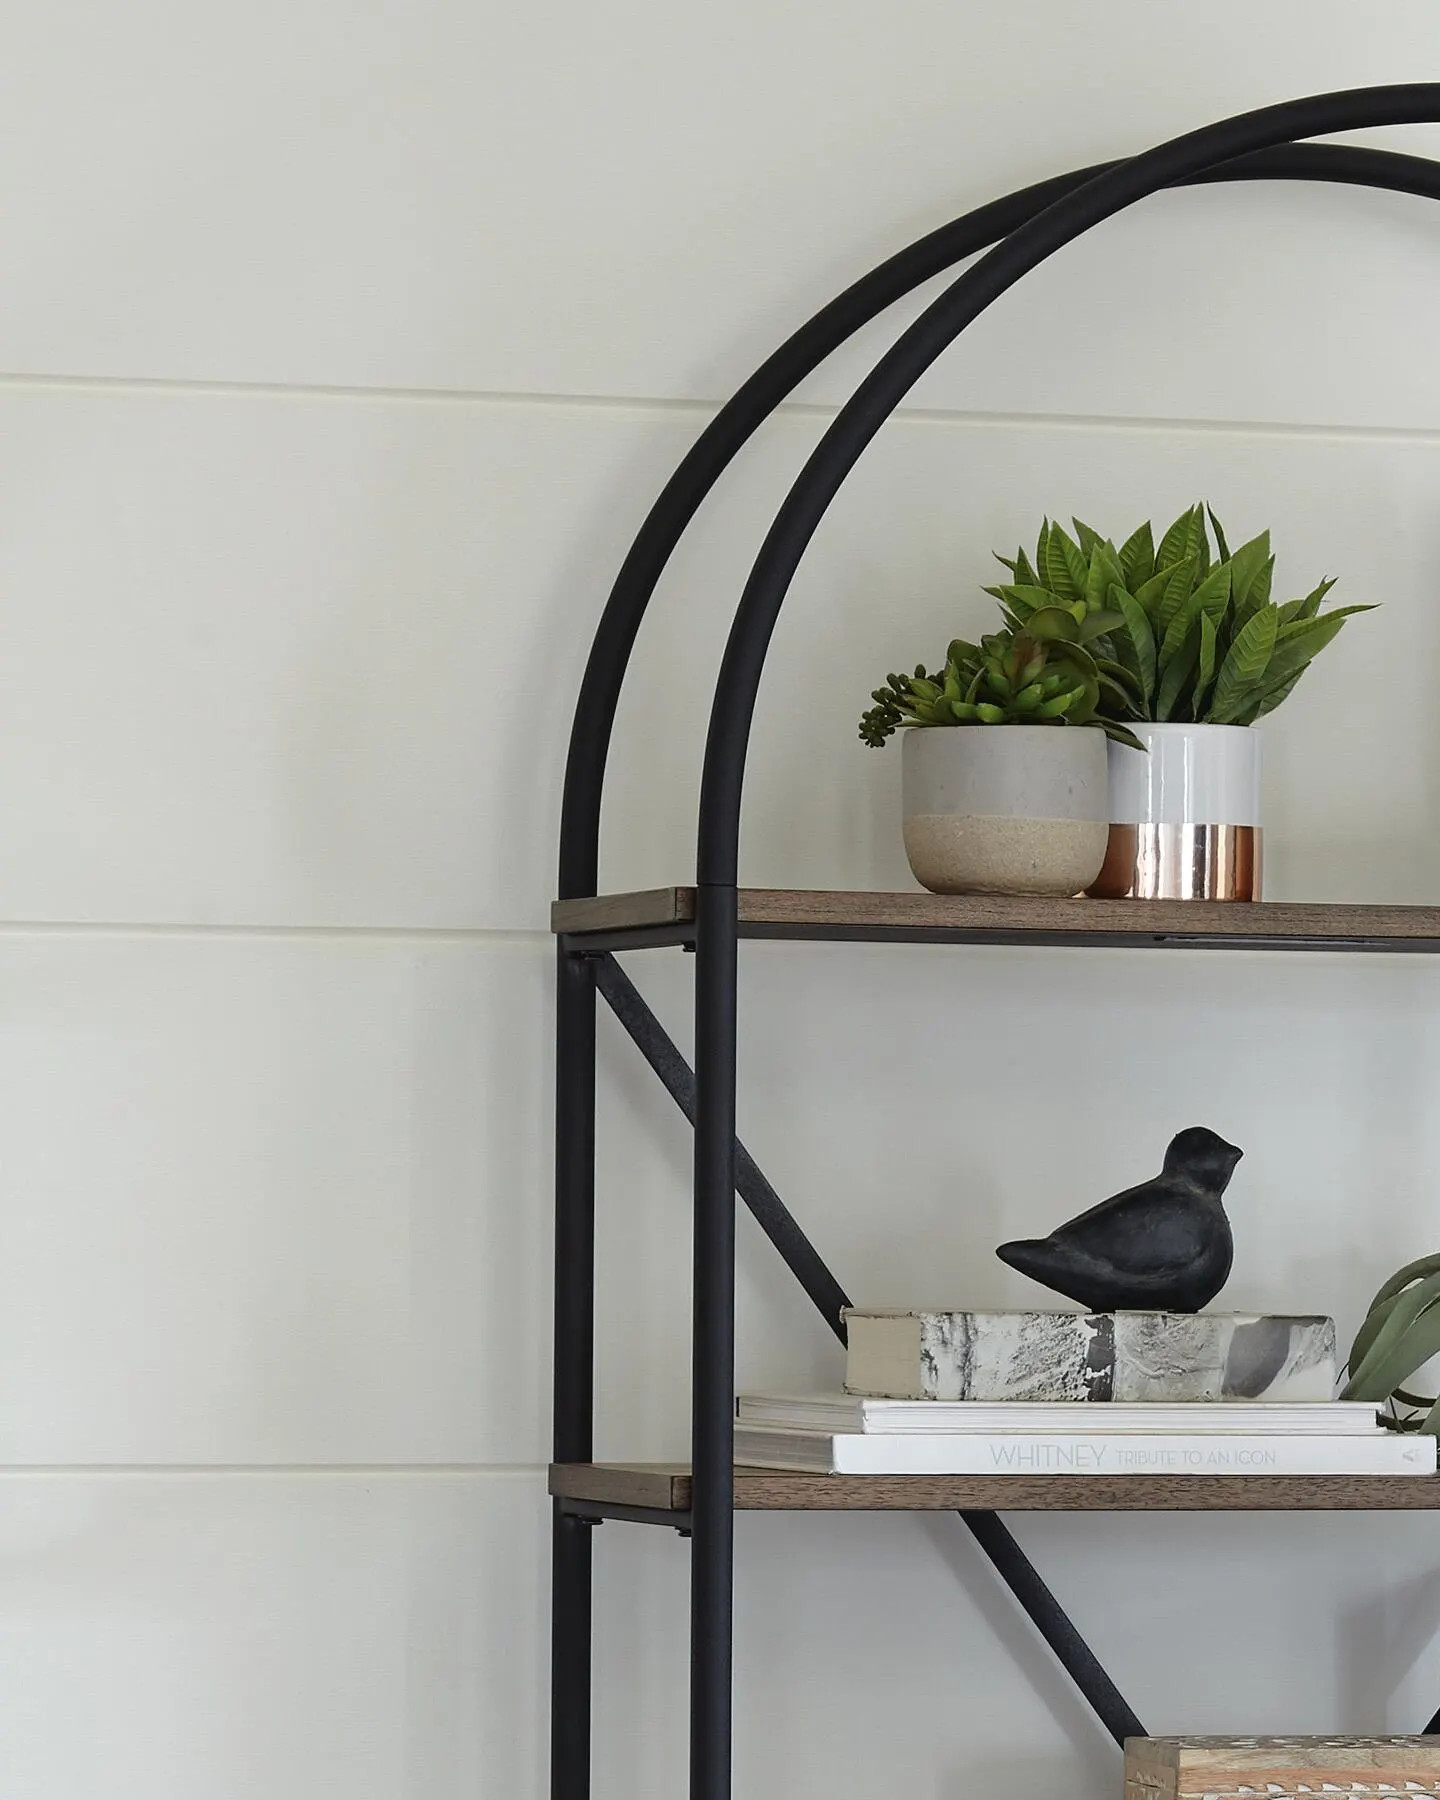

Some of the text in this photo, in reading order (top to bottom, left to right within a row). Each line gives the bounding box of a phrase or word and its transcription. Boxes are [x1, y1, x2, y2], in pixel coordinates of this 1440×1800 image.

[990, 1444, 1276, 1467] WHITNEY TRIBUTE TO AN ICON
